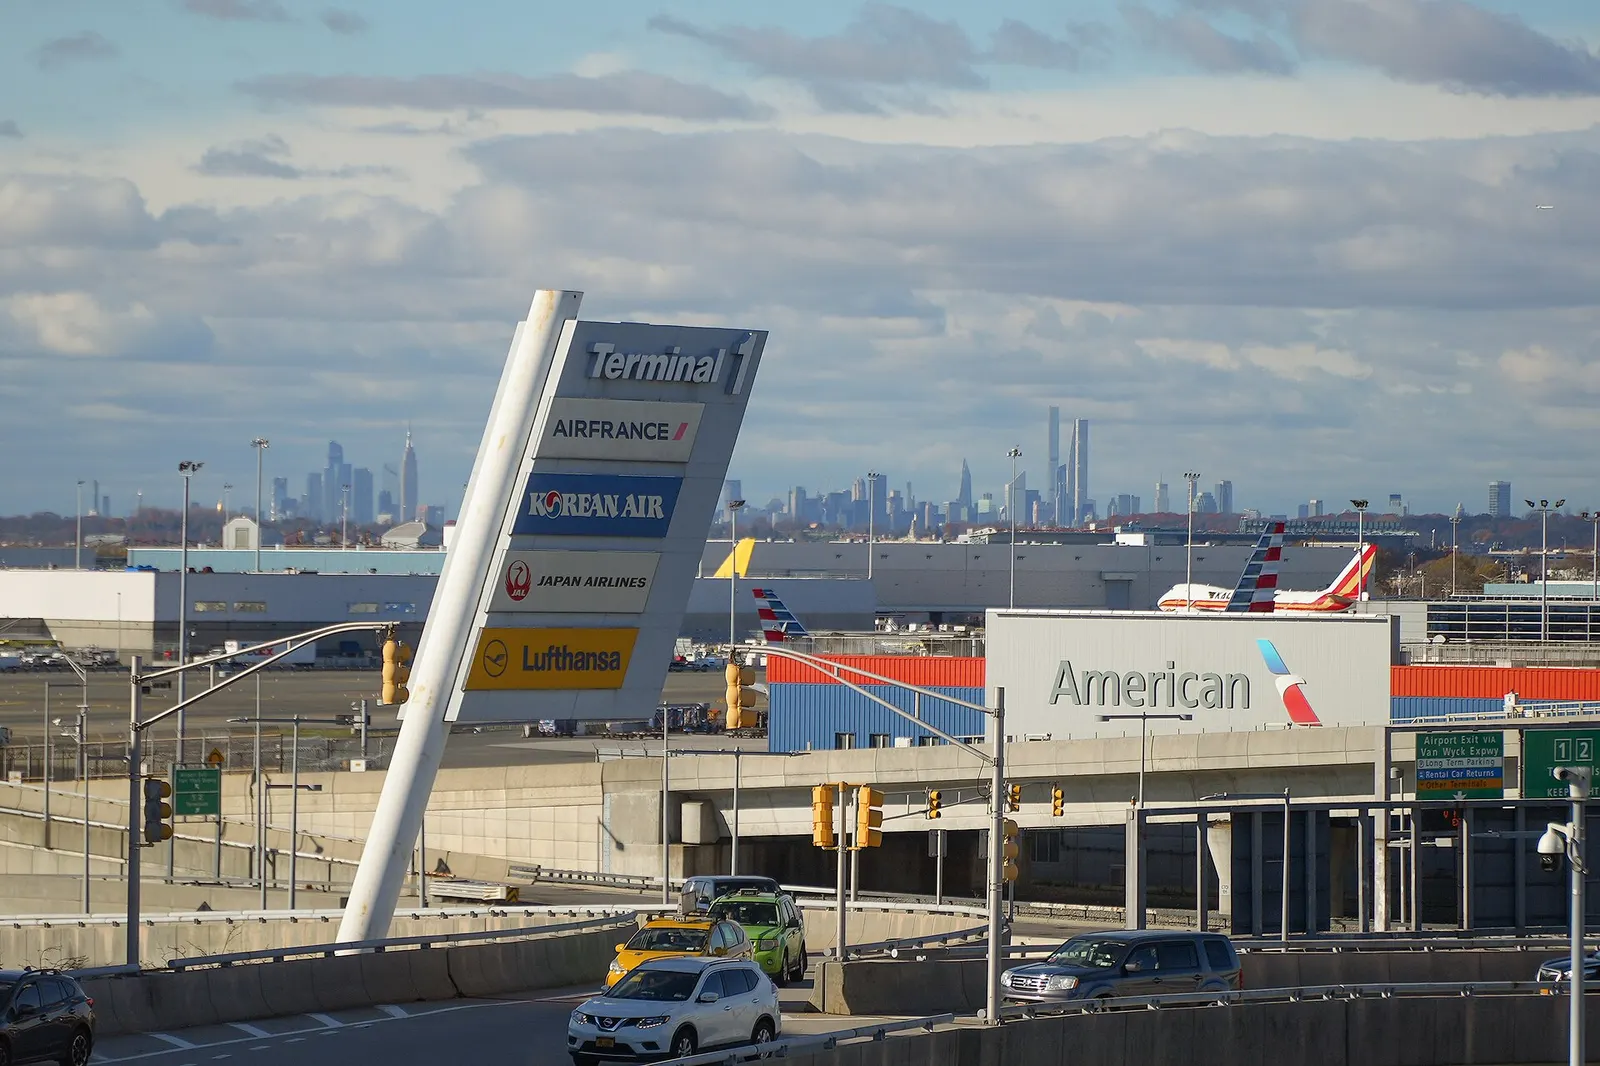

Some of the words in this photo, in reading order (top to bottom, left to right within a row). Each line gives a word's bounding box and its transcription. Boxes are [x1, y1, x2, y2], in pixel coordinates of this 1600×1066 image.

[591, 342, 727, 384] Terminal
[732, 333, 758, 395] 1
[553, 419, 669, 441] AIRFRANCE
[528, 490, 619, 519] KOREAN
[621, 493, 665, 520] AIR
[537, 575, 583, 587] JAPAN
[583, 576, 647, 588] AIRLINES
[511, 589, 526, 597] JAL
[523, 645, 621, 671] Lufthansa
[1048, 660, 1250, 709] American
[1424, 736, 1457, 746] Airport
[1461, 735, 1479, 744] Exit
[1483, 736, 1496, 744] VIA
[1420, 748, 1438, 757] Van
[1443, 747, 1466, 757] Wyck
[1469, 746, 1499, 757] Expwy
[1558, 742, 1566, 758] 1
[1579, 742, 1589, 758] 2
[1425, 760, 1443, 768] Long
[1467, 758, 1495, 767] Parking
[1425, 770, 1449, 779] Rental
[1451, 770, 1464, 778] Car
[1466, 769, 1495, 777] Returns
[1425, 781, 1447, 789] Other
[1450, 780, 1487, 788] Terminals
[1547, 787, 1569, 797] KEEP
